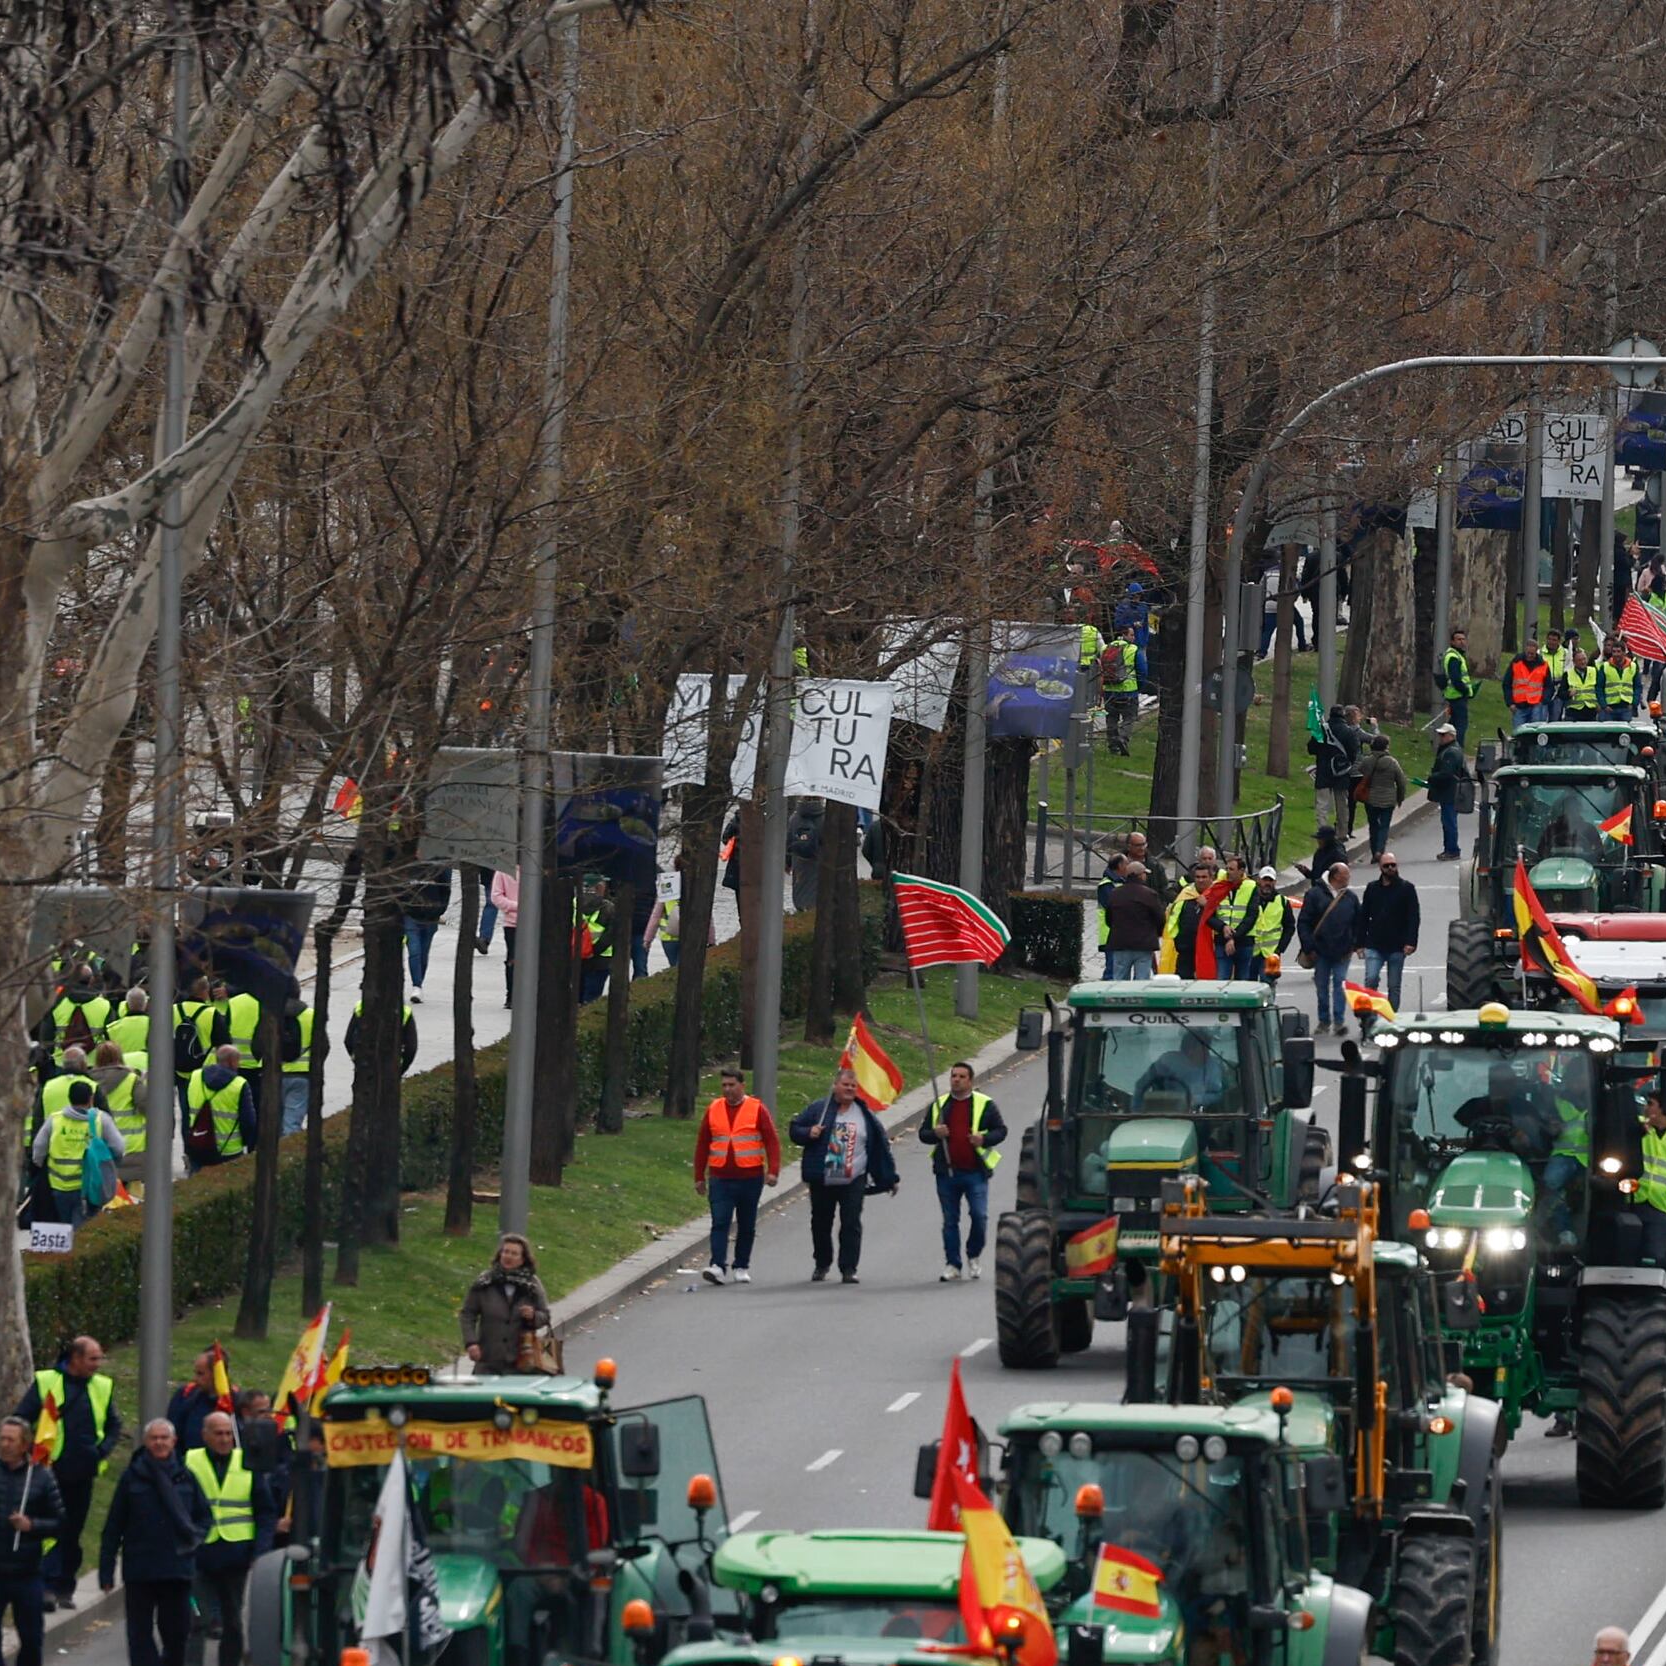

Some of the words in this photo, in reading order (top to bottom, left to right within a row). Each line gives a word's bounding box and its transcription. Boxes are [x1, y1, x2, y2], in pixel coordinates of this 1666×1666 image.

[1548, 419, 1595, 442] CUL
[1557, 442, 1585, 463] TU
[1570, 464, 1601, 486] RA
[801, 688, 873, 718] CUL
[809, 717, 857, 746] TU
[829, 747, 877, 786] RA
[821, 785, 856, 799] MADRID
[1129, 1013, 1190, 1025] QUILES
[444, 1428, 469, 1449] DE
